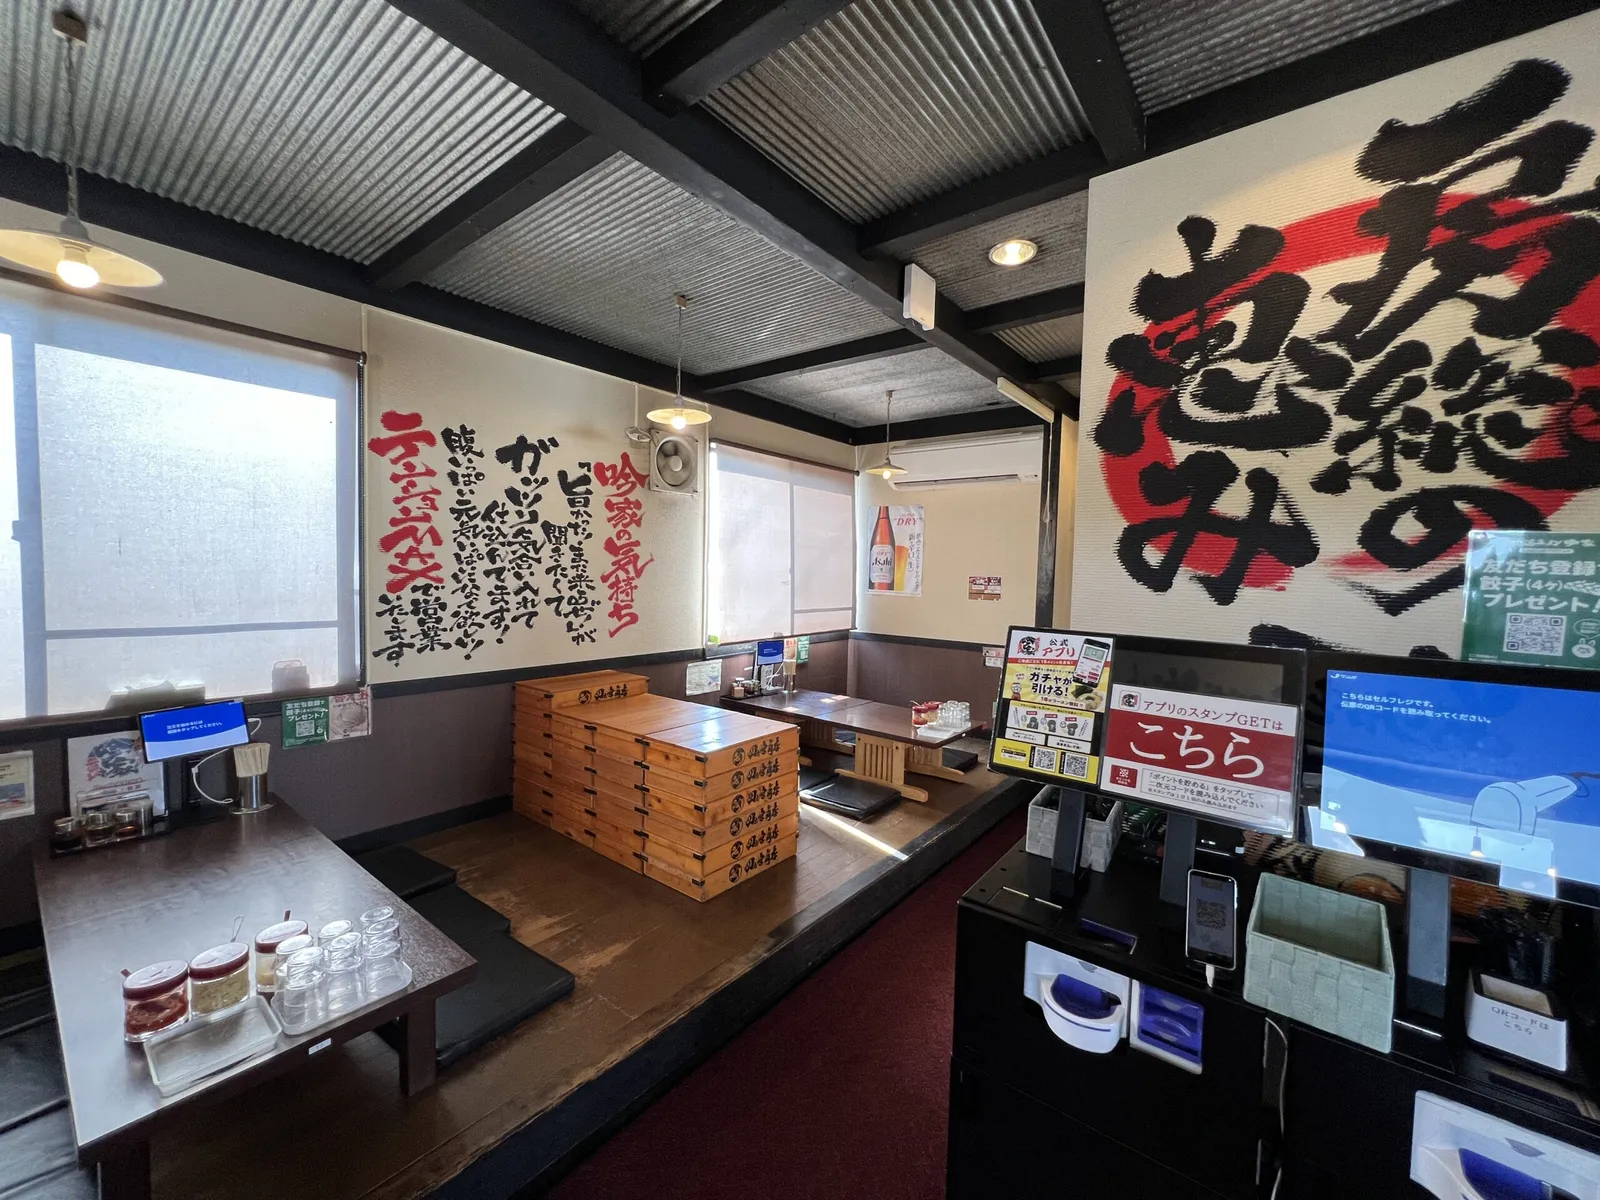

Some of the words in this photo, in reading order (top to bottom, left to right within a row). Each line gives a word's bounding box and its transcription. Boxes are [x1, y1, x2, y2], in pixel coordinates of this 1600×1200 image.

[593, 452, 654, 638] 吟家の気持ち
[541, 520, 568, 617] 聞きたくて
[1482, 559, 1600, 576] 友だち登録
[1483, 592, 1600, 613] プレゼント!
[410, 583, 453, 654] で営業
[1049, 638, 1069, 647] 公式
[1042, 647, 1076, 658] アプリ
[1029, 671, 1073, 685] ガチャが
[1031, 682, 1069, 697] 引ける!
[1341, 692, 1434, 708] こちらはセルフレジです。
[288, 712, 324, 722] プレゼント!
[1144, 700, 1284, 731] アプリのスタンプGETは
[1129, 722, 1265, 779] こちら
[1491, 1006, 1550, 1030] QRコードは
[1503, 1020, 1533, 1035] こちら
